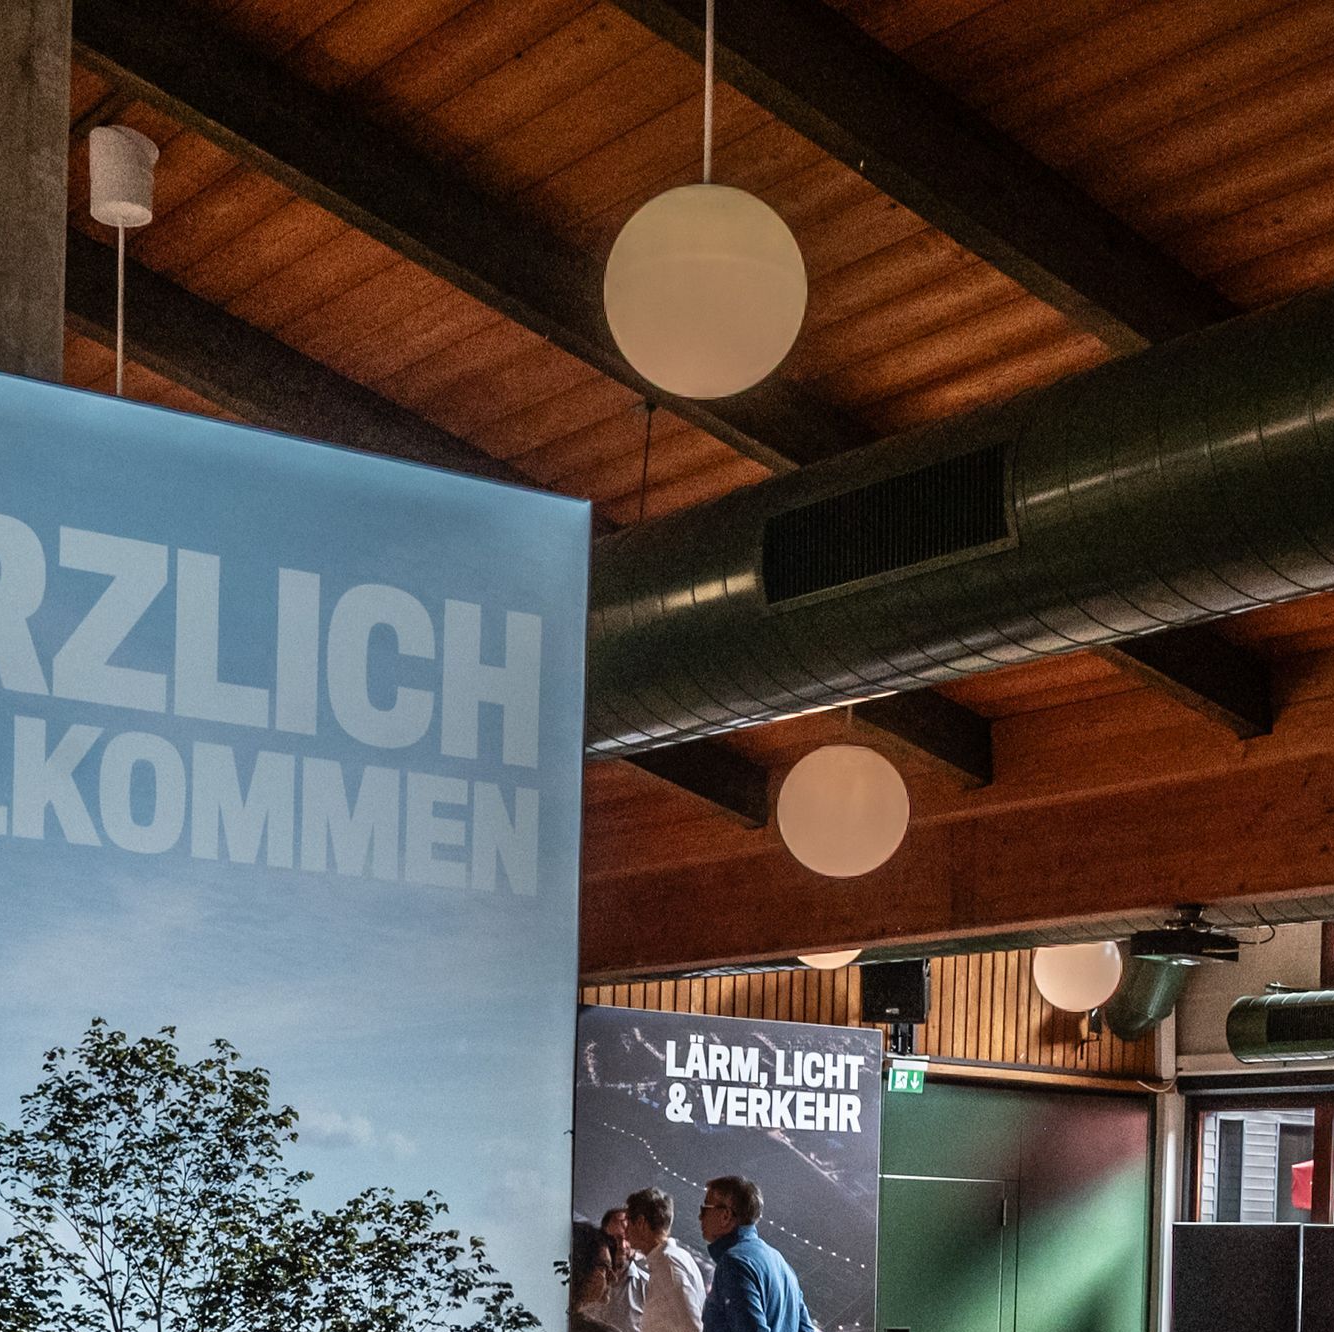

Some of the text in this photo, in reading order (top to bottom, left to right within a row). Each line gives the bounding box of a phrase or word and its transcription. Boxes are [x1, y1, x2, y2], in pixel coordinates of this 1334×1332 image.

[665, 1034, 865, 1090] LÄRM, LICHT
[665, 1082, 862, 1133] & VERKEHR
